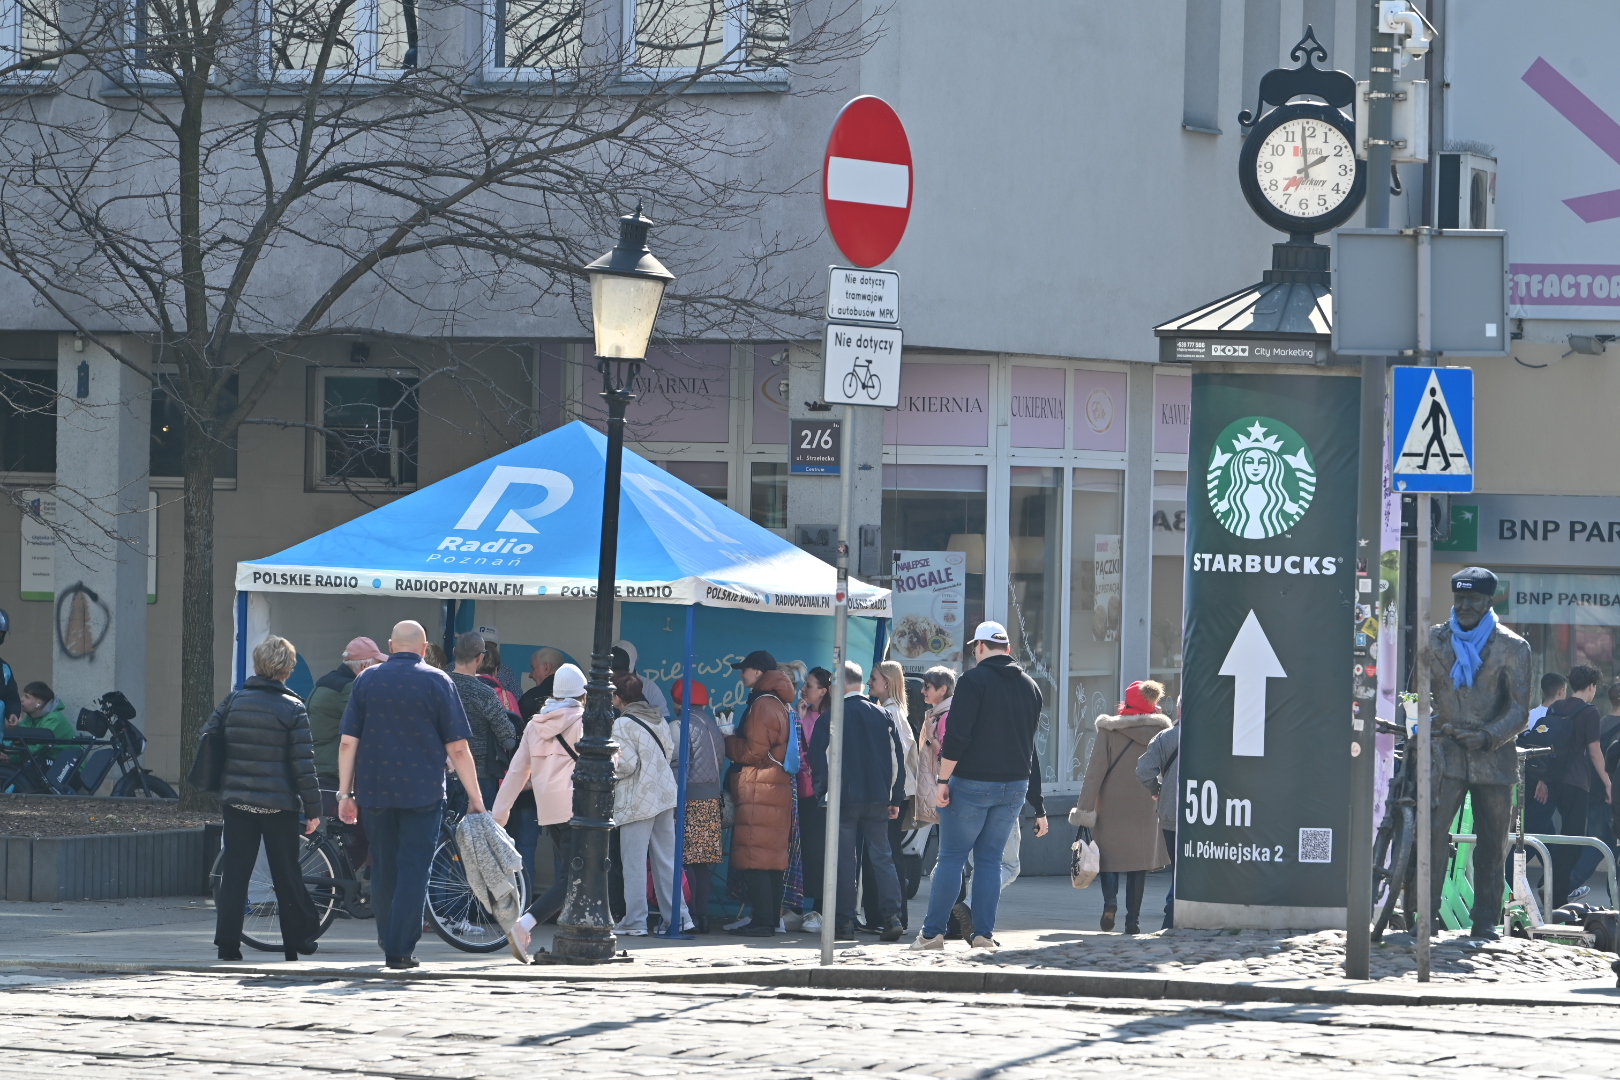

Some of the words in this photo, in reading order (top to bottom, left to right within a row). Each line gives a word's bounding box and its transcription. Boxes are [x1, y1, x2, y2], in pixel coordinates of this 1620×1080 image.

[1284, 131, 1296, 143] 11
[1322, 131, 1329, 144] 1
[1270, 144, 1285, 157] 10
[1299, 145, 1322, 158] gzeta
[1333, 145, 1343, 157] 2
[1263, 162, 1273, 174] 9
[1338, 164, 1348, 176] 3
[1268, 179, 1278, 191] 8
[1331, 183, 1341, 195] 4
[1282, 193, 1292, 205] 7
[1299, 199, 1308, 210] 6
[1317, 194, 1327, 206] 5
[844, 273, 856, 284] Nie
[860, 274, 885, 290] dotyczy
[845, 291, 883, 304] tramwajów
[831, 304, 834, 315] i
[837, 306, 876, 318] autobusów
[879, 308, 895, 319] MPK
[834, 331, 852, 348] Nie
[856, 334, 894, 355] dotyczy
[1254, 347, 1270, 358] City
[1273, 347, 1314, 358] Marketing
[884, 396, 983, 413] UKIERNIA
[1010, 395, 1064, 420] CUKIERNIA
[800, 429, 833, 449] 2/6
[1499, 519, 1561, 541] BNP
[1569, 520, 1620, 543] PAR
[436, 536, 534, 555] Radio
[425, 553, 522, 567] Poznań
[896, 557, 930, 572] NAJLEPSZE
[1095, 558, 1120, 580] PĄCZKI
[253, 571, 311, 587] POLSKIE
[315, 574, 358, 589] RADIO
[395, 578, 524, 596] RADIOPOZNAN.FM
[896, 567, 953, 593] ROGALE
[560, 585, 622, 598] POLSE
[626, 585, 673, 598] RADIO
[706, 586, 738, 602] POLSKIE
[1516, 591, 1553, 605] BNP
[847, 598, 868, 609] OLSKIE
[1185, 779, 1219, 826] 50
[1225, 798, 1252, 827] m
[1184, 840, 1195, 858] ul.
[1196, 840, 1271, 864] Półwiejska
[1274, 845, 1284, 862] 2
